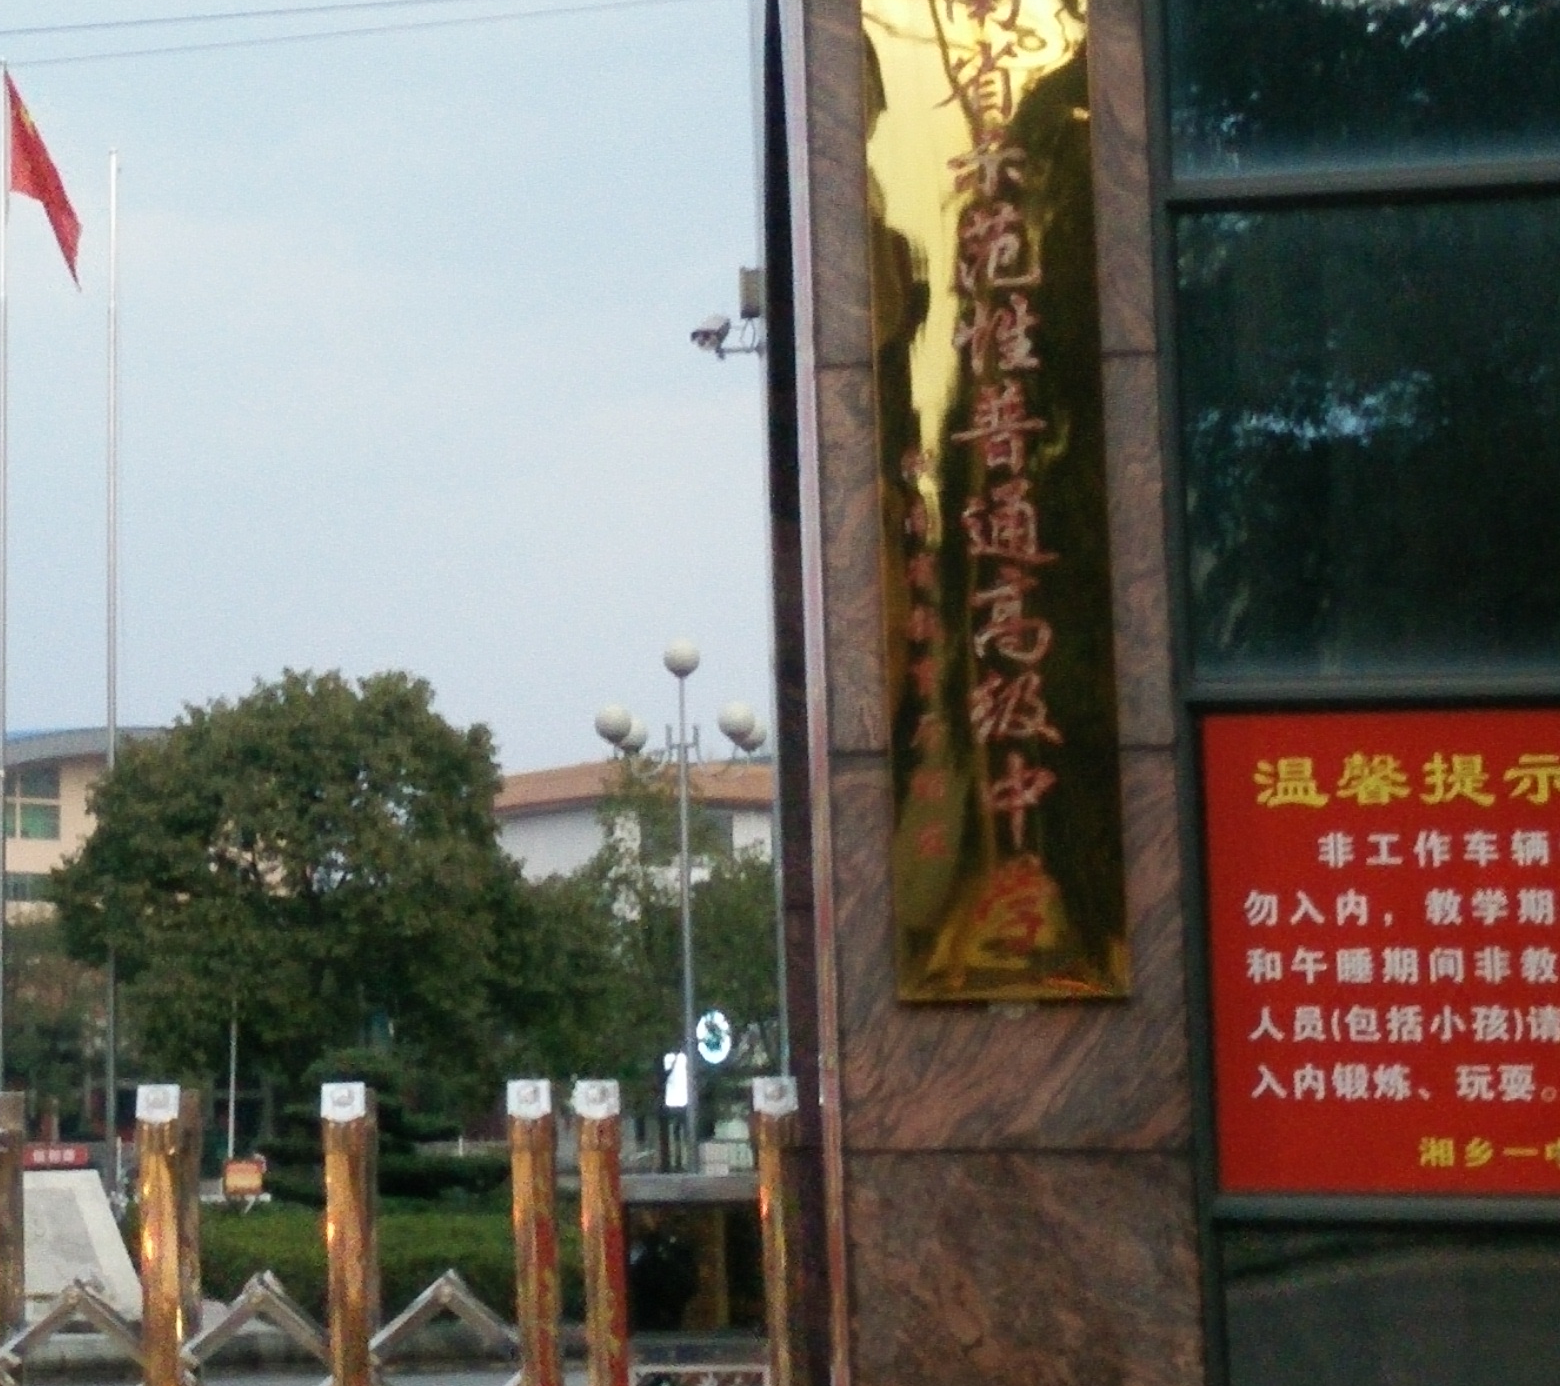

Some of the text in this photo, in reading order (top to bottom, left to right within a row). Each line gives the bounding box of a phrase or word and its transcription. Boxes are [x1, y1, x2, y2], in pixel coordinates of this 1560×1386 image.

[1252, 750, 1560, 809] 温馨提示
[1317, 828, 1550, 869] 非工作车辆
[1243, 887, 1556, 927] 勿入内，教学期
[1246, 945, 1558, 985] 和午睡期间非教
